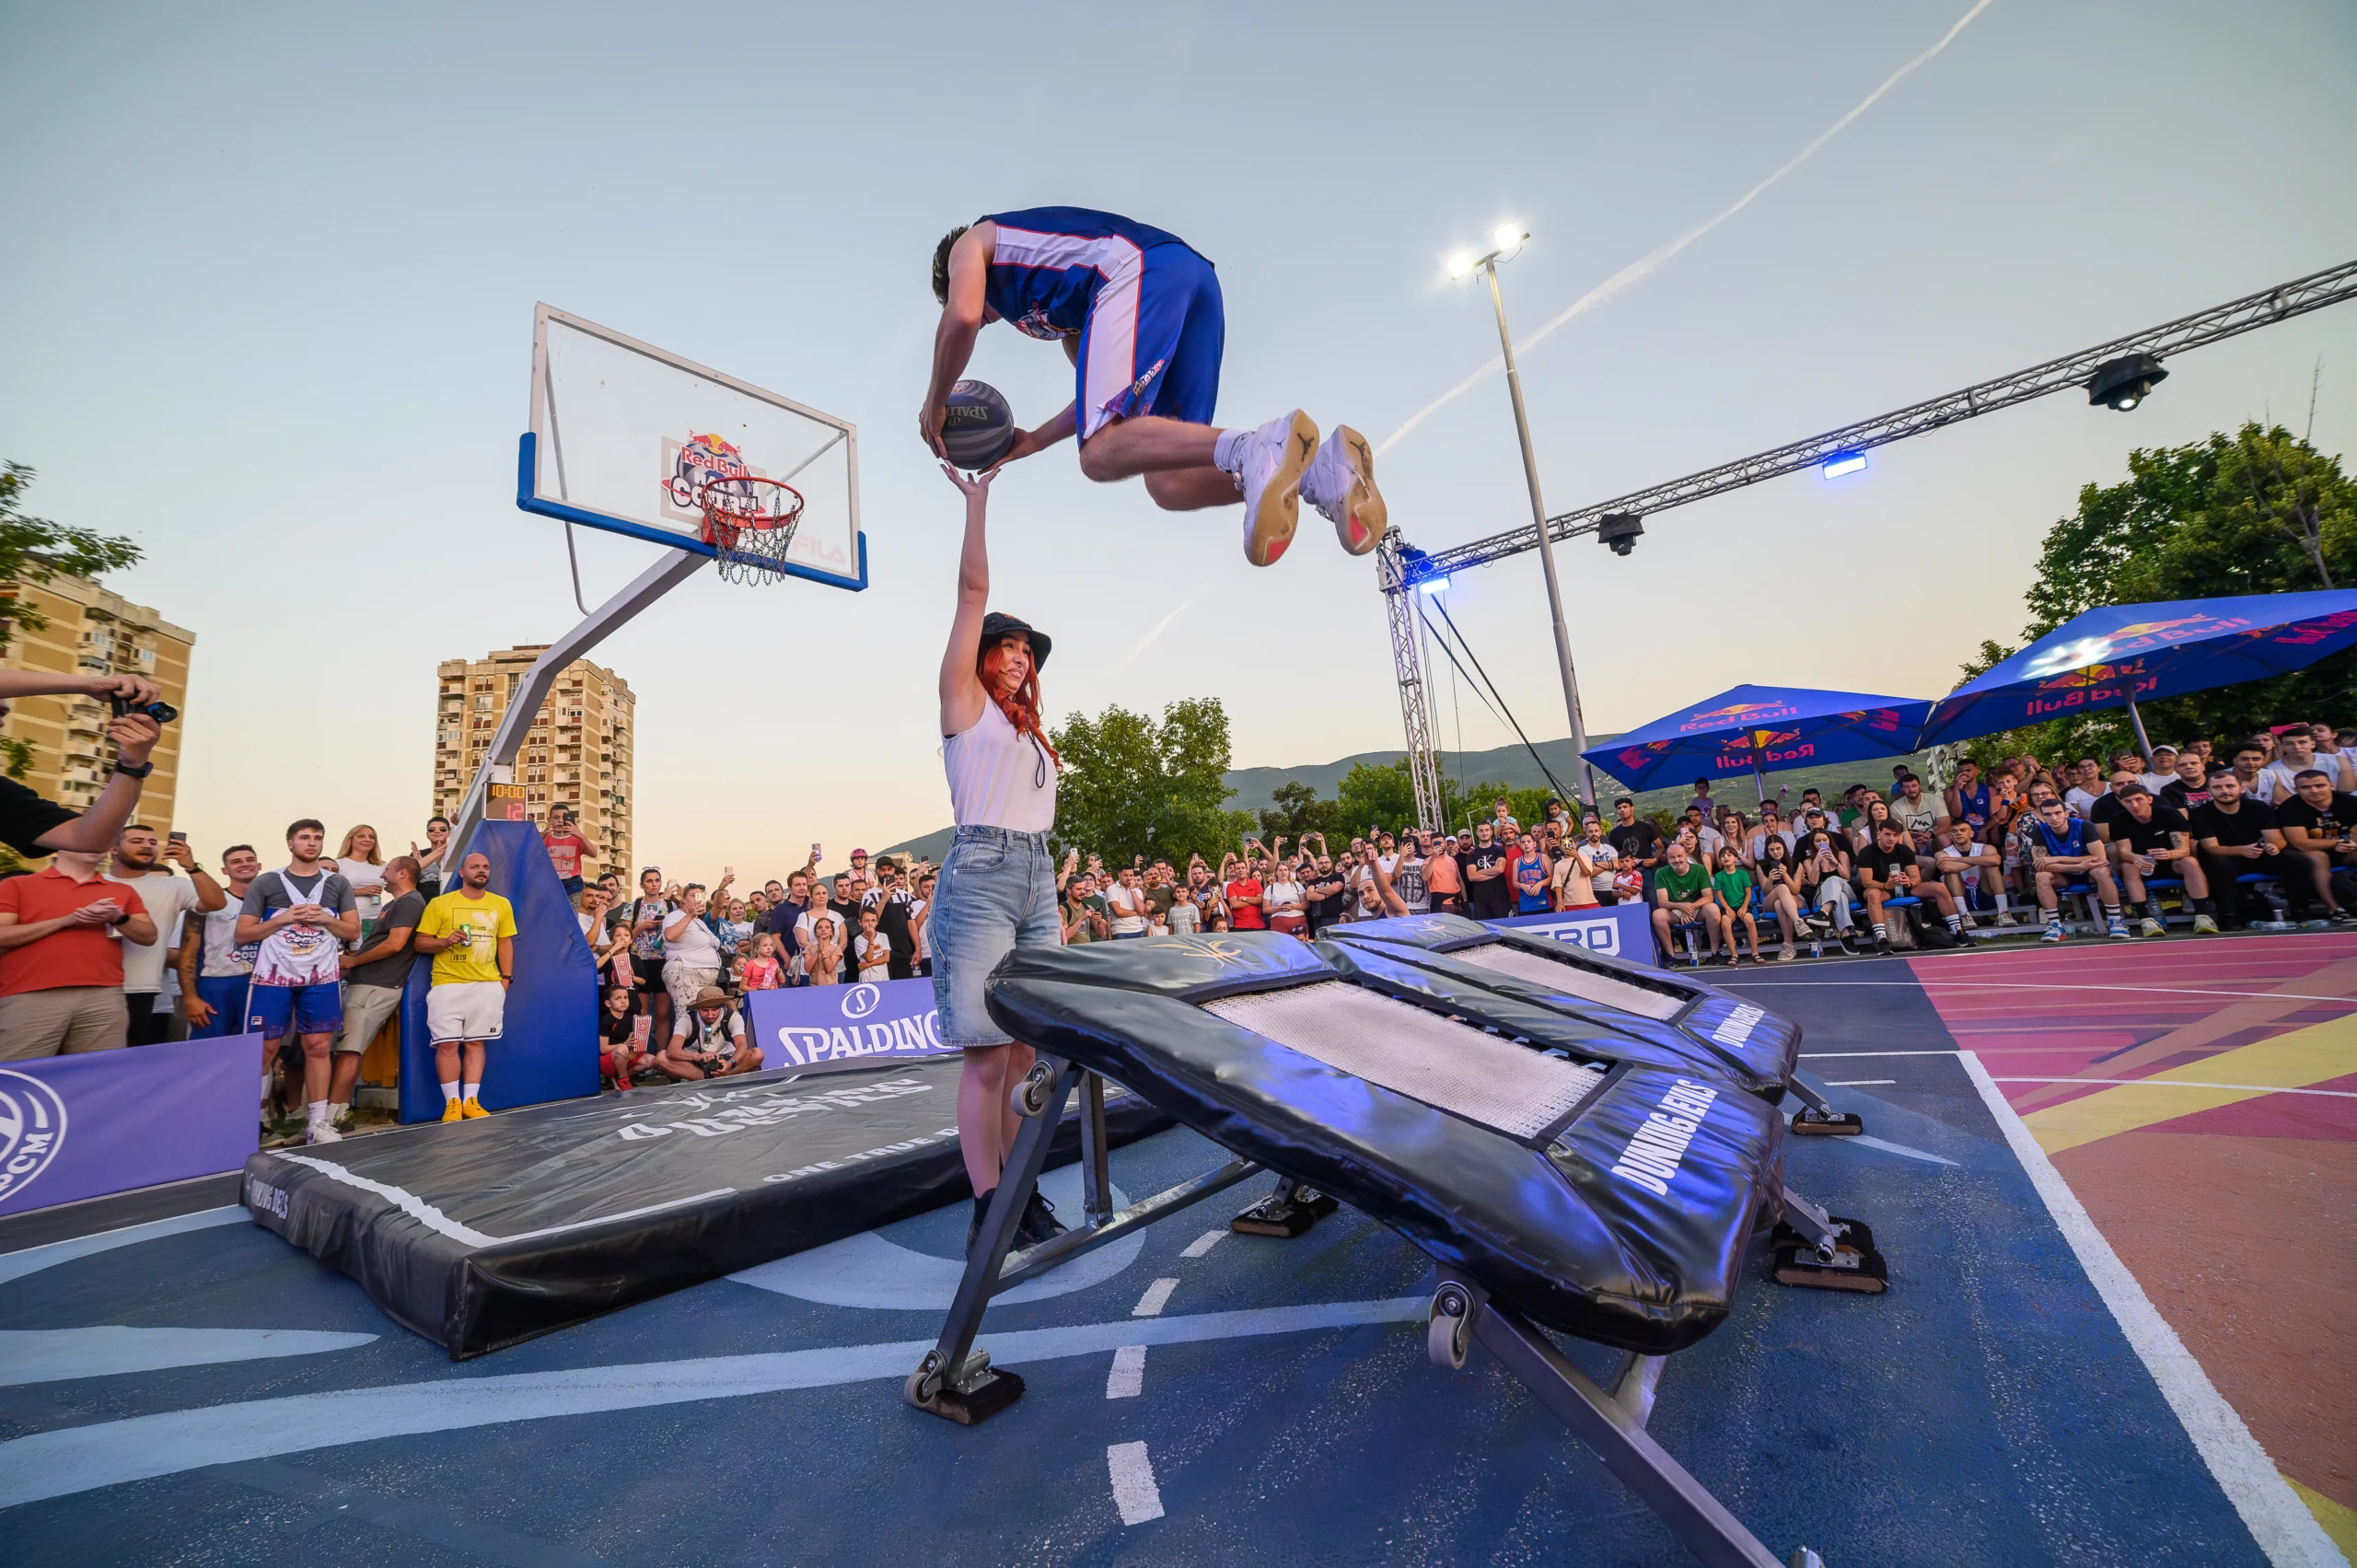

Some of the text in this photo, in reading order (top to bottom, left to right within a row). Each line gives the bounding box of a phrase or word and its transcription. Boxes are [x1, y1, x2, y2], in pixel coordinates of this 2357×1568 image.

[947, 406, 988, 420] SPALD
[681, 447, 748, 478] Red Bull
[793, 533, 846, 566] FILA
[1680, 707, 1797, 732] Red Bull
[492, 784, 525, 798] 10:00
[506, 803, 524, 821] 12
[779, 1010, 955, 1068] SPALDING
[762, 1137, 935, 1182] ONE TRUE
